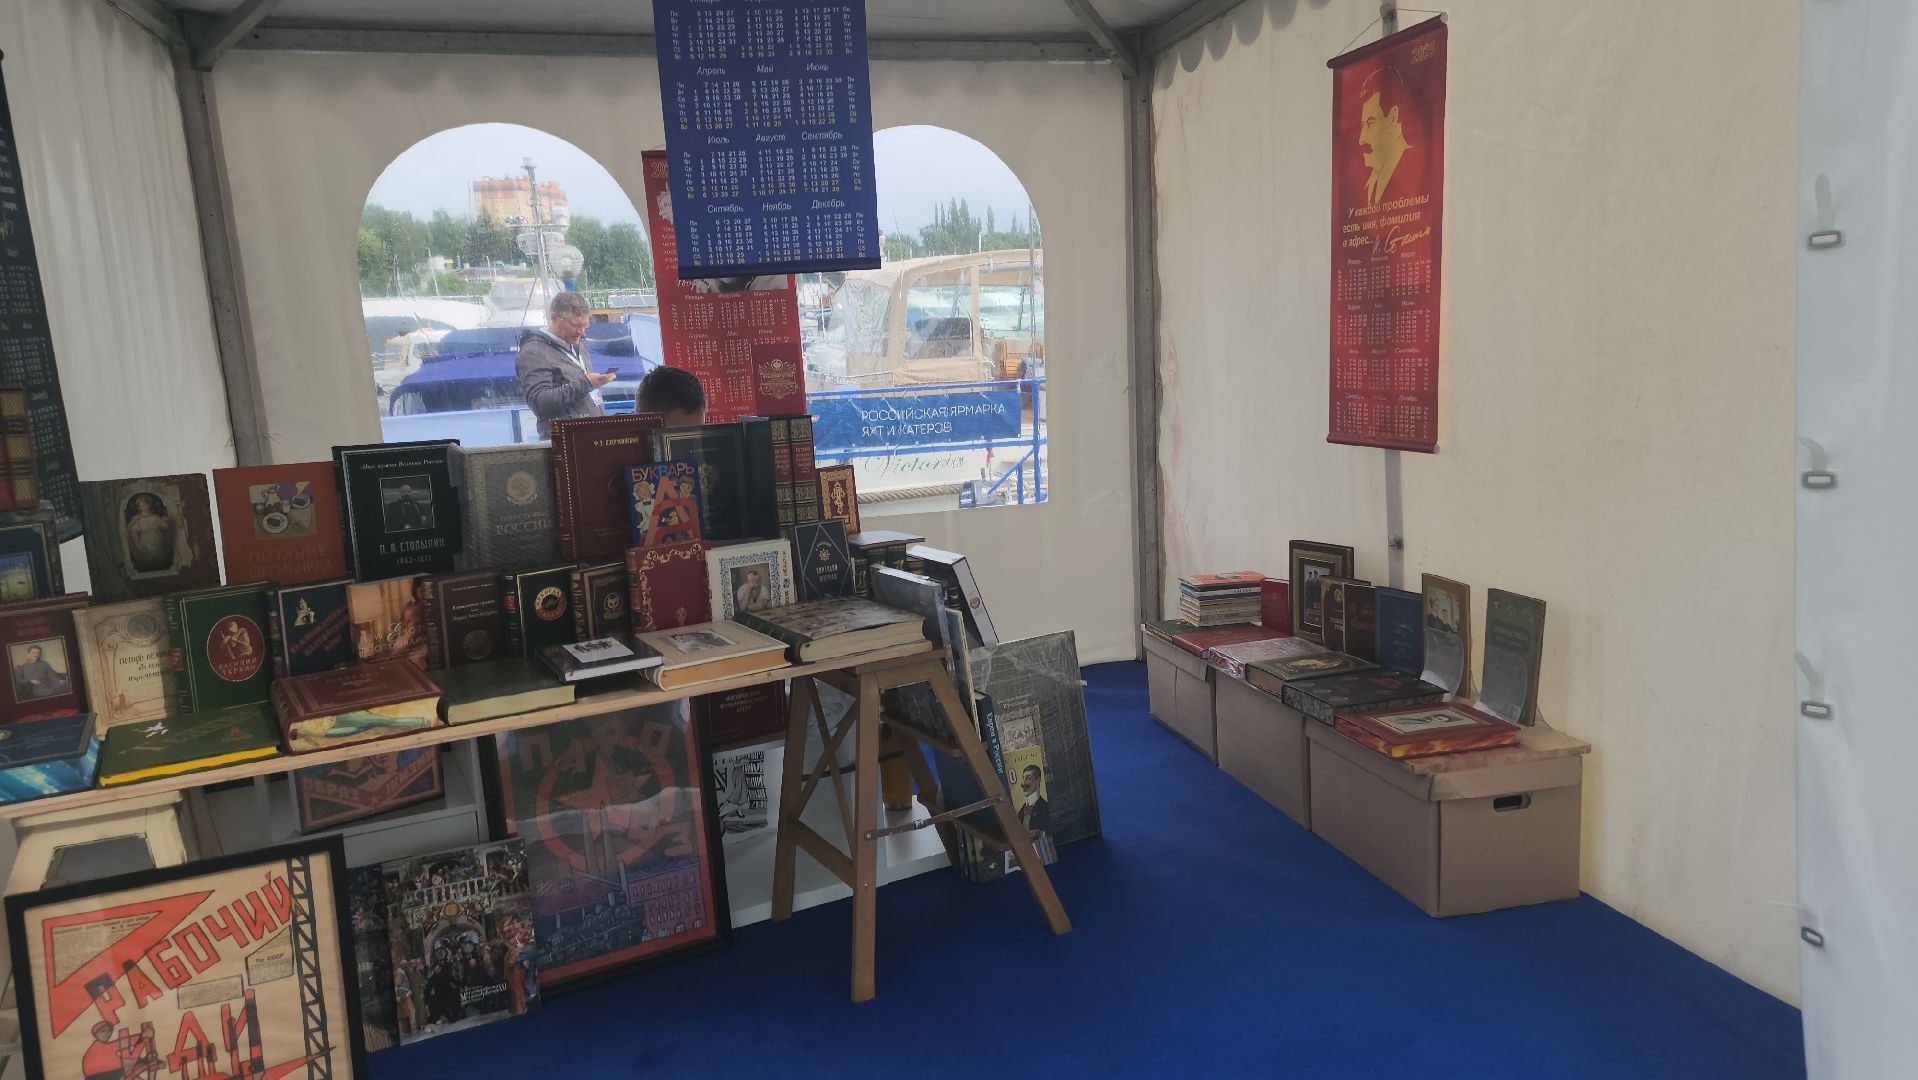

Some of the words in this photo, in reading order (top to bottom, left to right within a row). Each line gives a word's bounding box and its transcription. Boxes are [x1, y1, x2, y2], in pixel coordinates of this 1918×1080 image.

[756, 64, 774, 72] Май
[755, 133, 785, 143] Август
[762, 201, 791, 212] Ноябрь
[1382, 194, 1429, 213] проблемы
[1343, 224, 1361, 233] есть
[1379, 211, 1421, 229] фамилия
[861, 406, 947, 422] РОССИЙСКАЯ
[950, 403, 1005, 417] ЯРМАРКА
[862, 426, 883, 437] ЯХТ
[886, 426, 895, 436] И
[899, 421, 952, 436] КАТЕРОВ
[631, 462, 694, 482] БУКВАРЬ
[400, 537, 445, 552] СТОЛЫПИН
[85, 870, 293, 1026] РАБОЧИЙ
